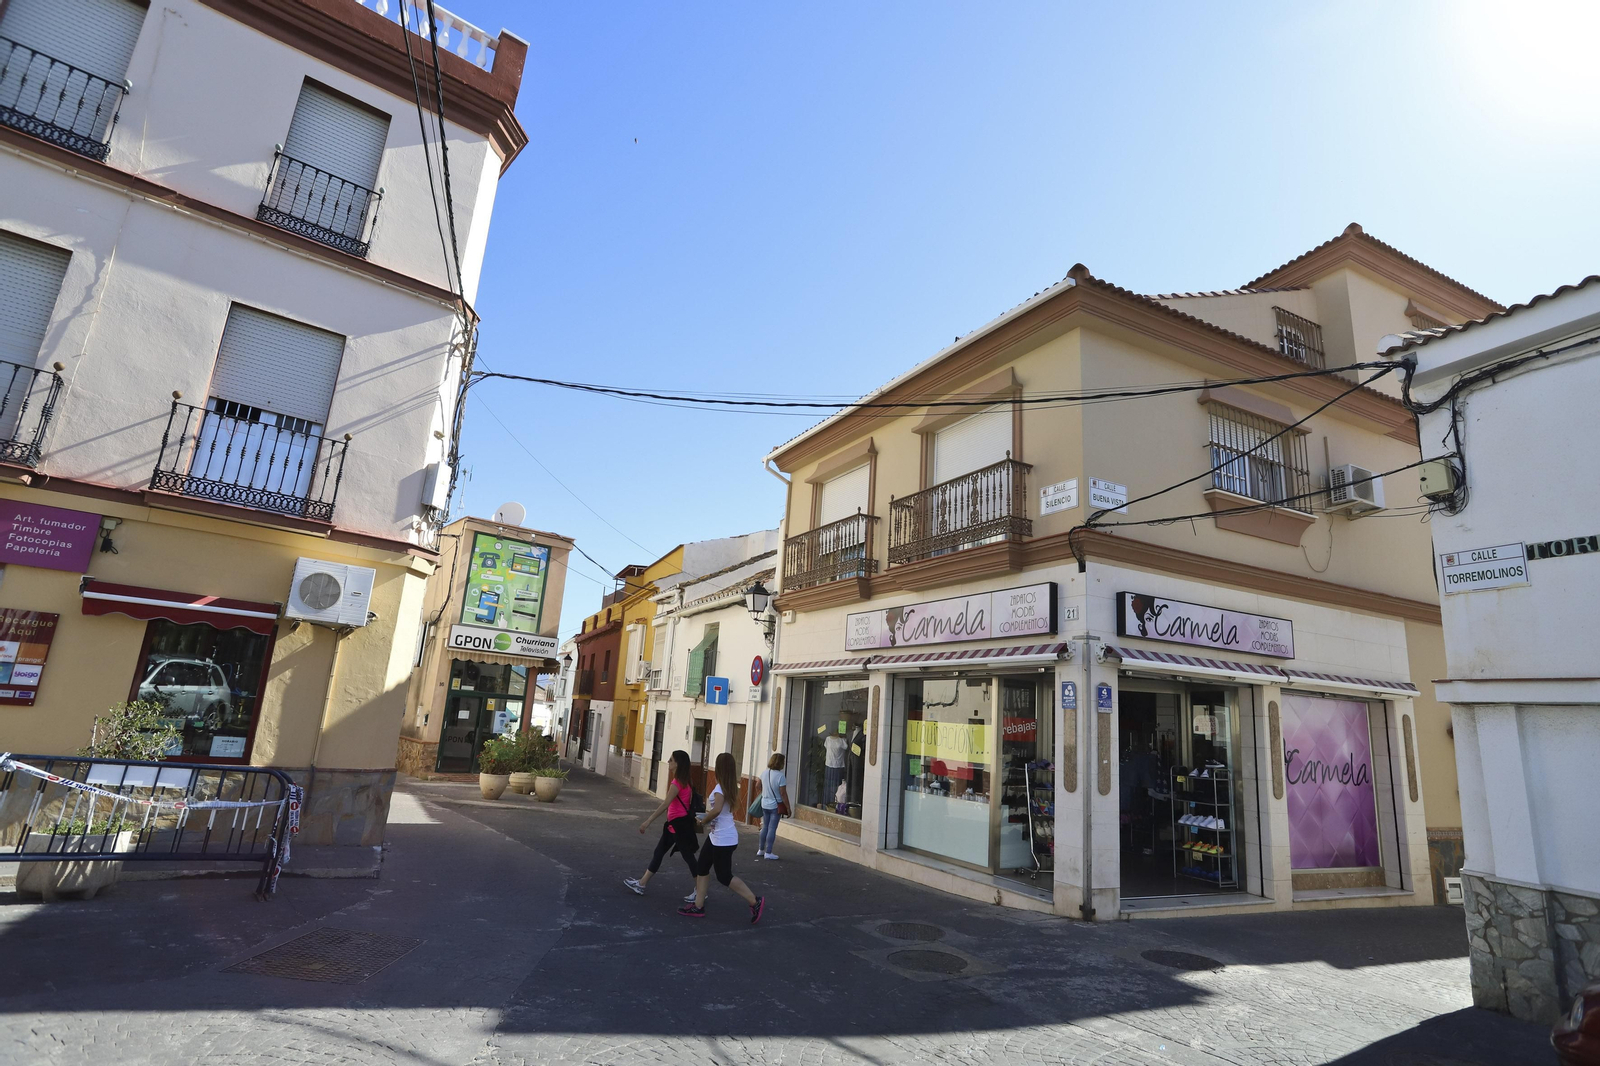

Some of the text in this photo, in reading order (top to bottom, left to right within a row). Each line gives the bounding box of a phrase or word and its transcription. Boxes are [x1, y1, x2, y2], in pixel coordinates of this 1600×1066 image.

[1053, 483, 1066, 493] CALLE
[1103, 482, 1117, 492] CALLE
[1045, 494, 1072, 508] SILENCIO
[1092, 493, 1110, 504] BUENA
[14, 513, 87, 531] Art. fumador
[12, 523, 52, 536] Timbre
[8, 532, 73, 549] Fotocopias
[5, 542, 61, 557] Papelería
[1471, 549, 1498, 561] CALLE
[1446, 565, 1524, 585] TORREMOLINOS
[1009, 591, 1037, 607] ZAPATOS
[1011, 605, 1036, 619] MODAS
[1066, 609, 1076, 619] 21
[903, 600, 986, 643] Carmela
[999, 616, 1048, 633] COMPLEMENTOS
[1154, 603, 1240, 646] Carmela
[1258, 618, 1279, 632] ZAPATOS
[454, 634, 492, 650] GPON
[515, 636, 556, 648] Churriana
[1260, 631, 1279, 643] MODAS
[519, 645, 549, 655] Televisión
[1251, 640, 1289, 655] COMPLEMENTOS
[1002, 720, 1037, 736] rebajas
[1286, 748, 1370, 787] Carmela
